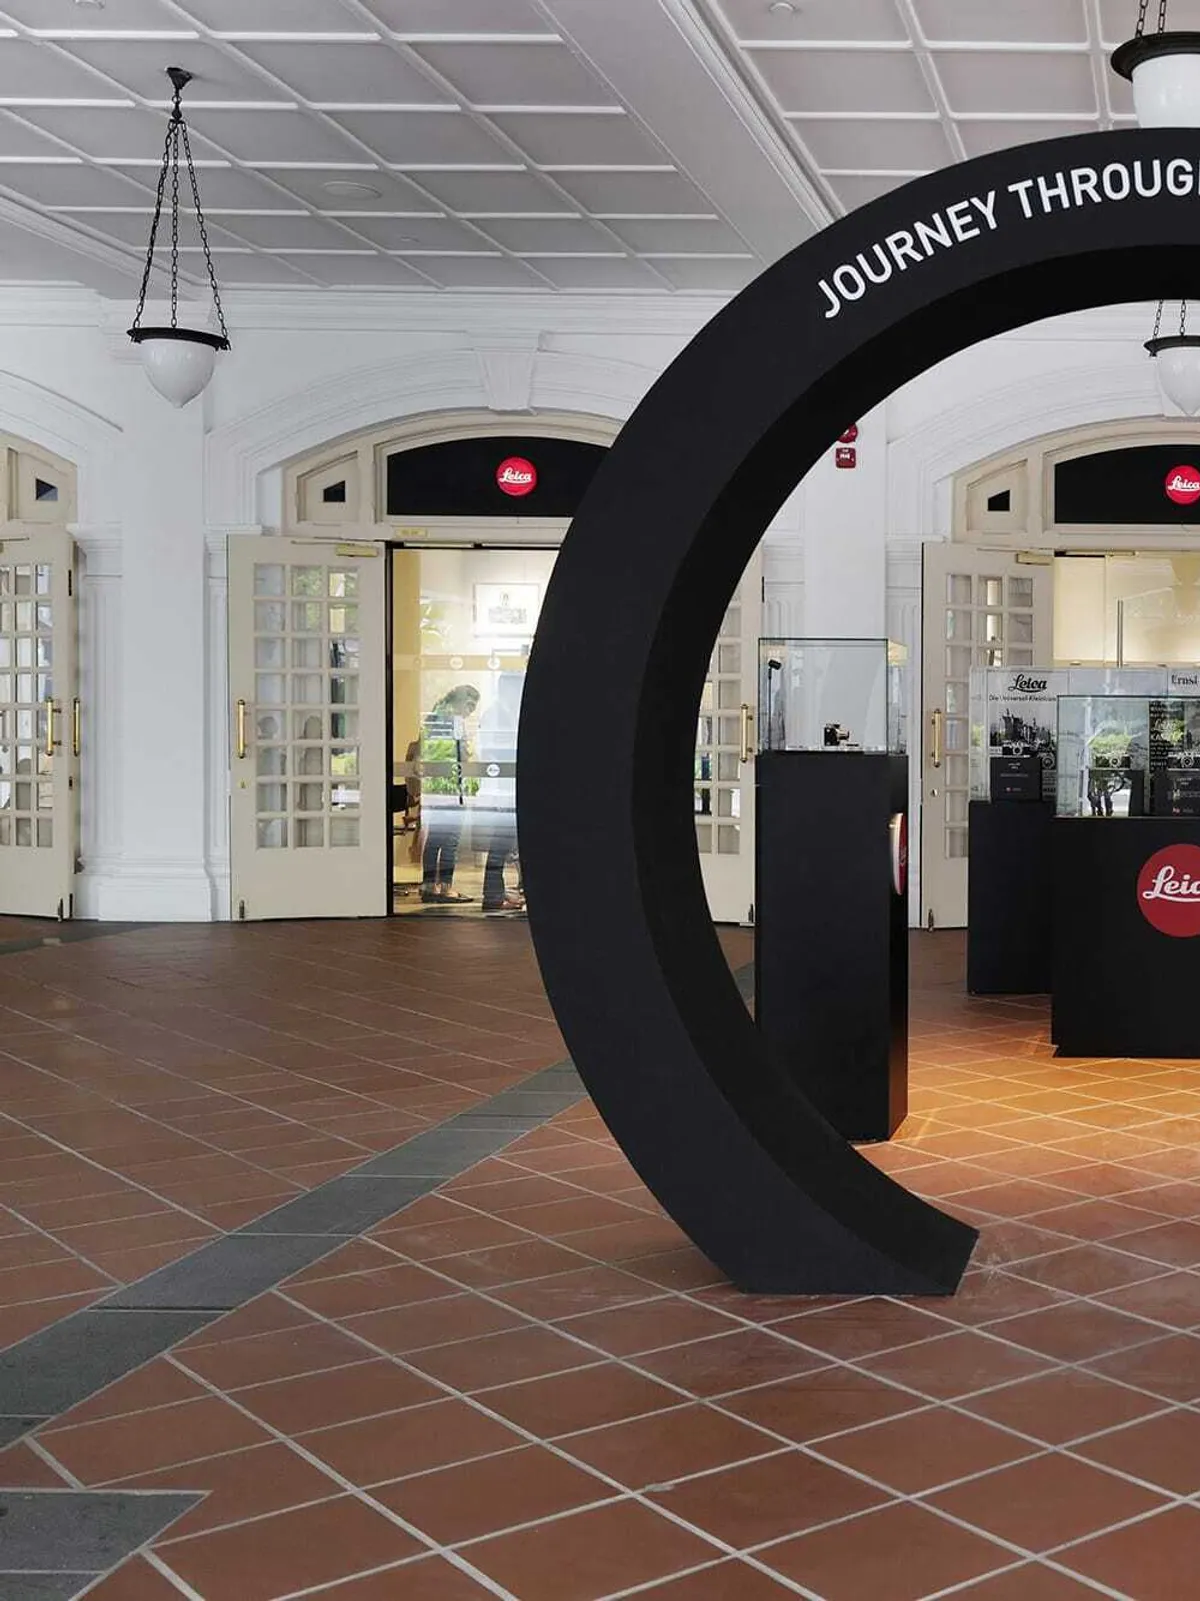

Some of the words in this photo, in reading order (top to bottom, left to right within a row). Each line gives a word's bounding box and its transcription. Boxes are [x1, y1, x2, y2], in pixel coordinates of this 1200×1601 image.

[816, 190, 998, 319] JOURNEY
[499, 466, 532, 484] Leica
[1167, 475, 1200, 492] Leica
[1008, 673, 1048, 693] Leica
